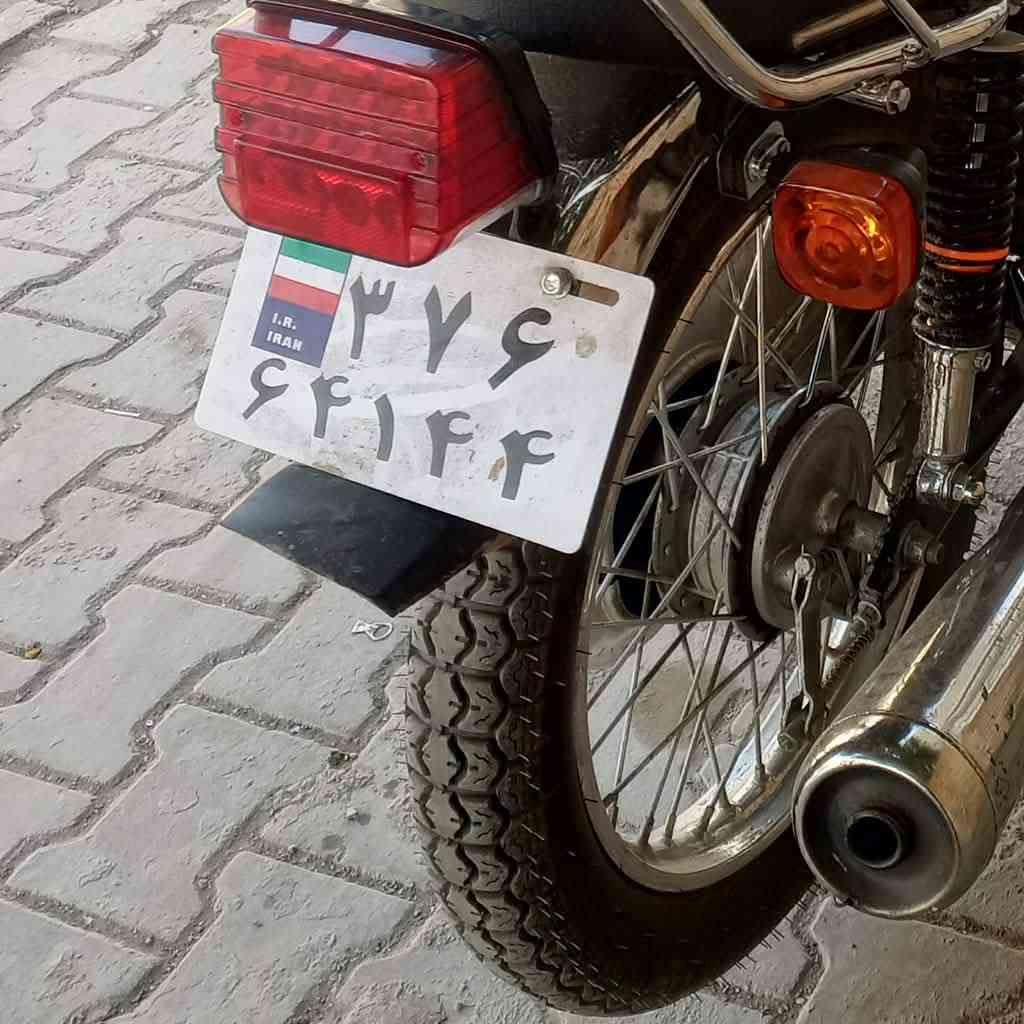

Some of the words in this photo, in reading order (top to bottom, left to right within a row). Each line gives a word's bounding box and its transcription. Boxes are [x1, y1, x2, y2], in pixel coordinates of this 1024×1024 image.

[265, 331, 303, 352] IRAN
[271, 312, 297, 331] I.R.
[349, 275, 555, 390] ۳۷۶
[242, 358, 556, 500] ۶۴۱۴۴
